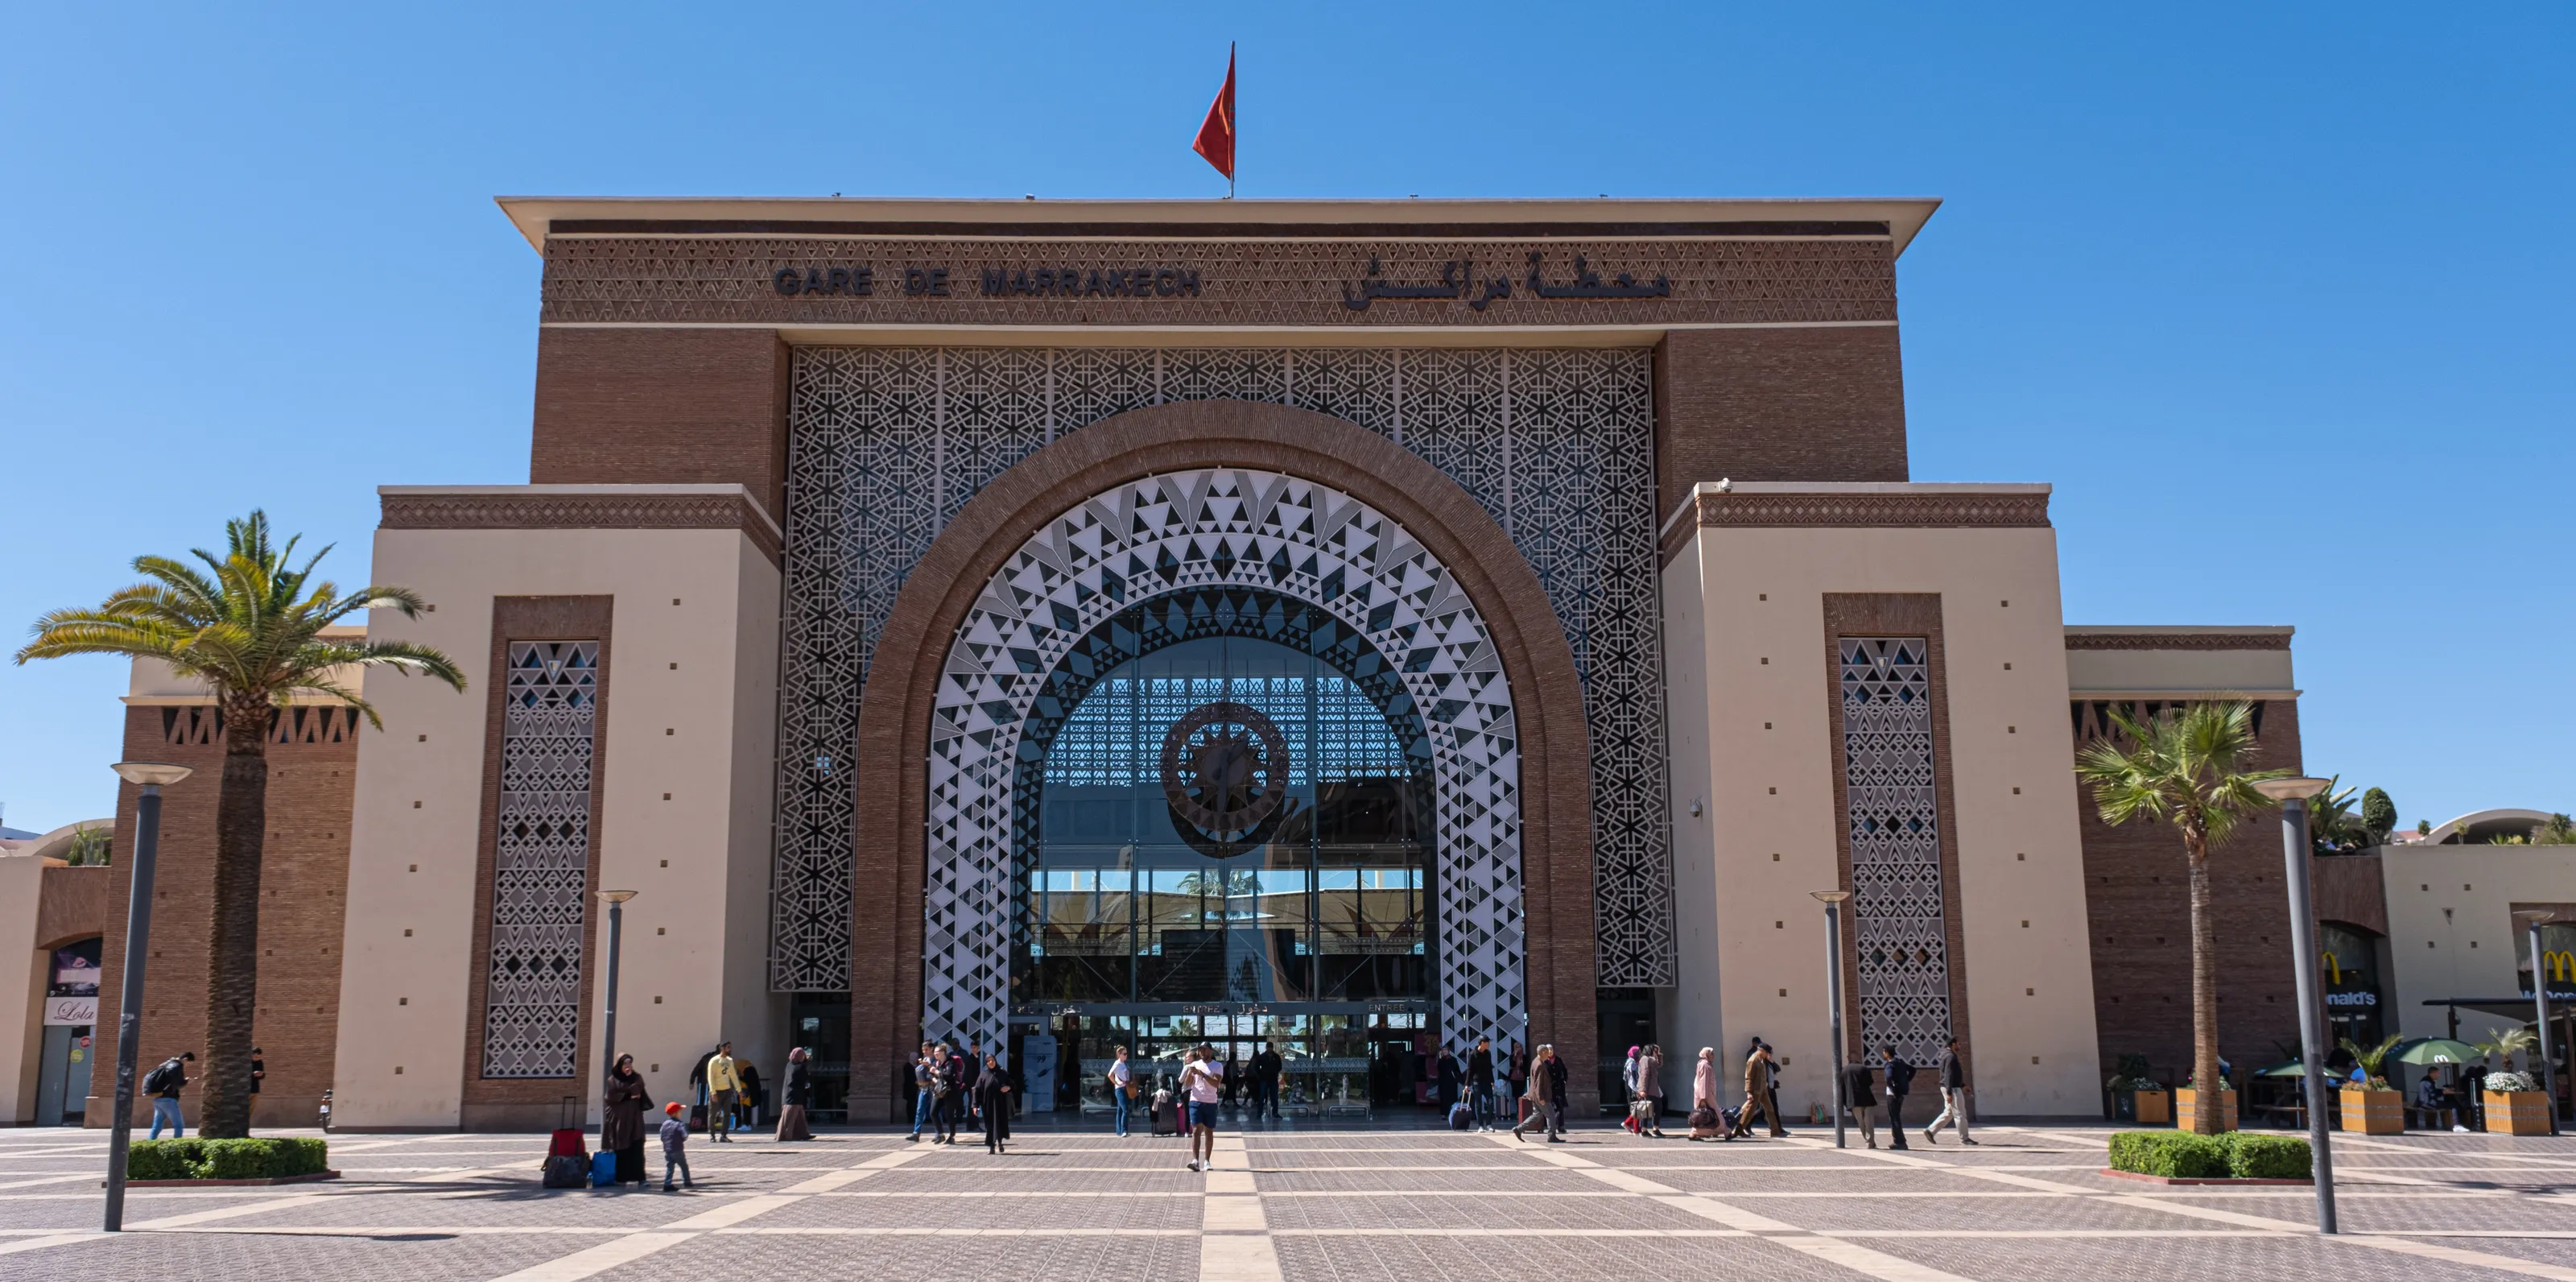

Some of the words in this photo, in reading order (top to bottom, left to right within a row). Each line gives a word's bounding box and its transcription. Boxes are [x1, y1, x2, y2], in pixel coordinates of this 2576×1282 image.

[774, 267, 873, 296] GARE
[904, 268, 949, 296] DE
[980, 269, 1200, 296] MARRAKECH
[1344, 254, 1511, 311] مراكش
[1526, 250, 1670, 298] محطة
[53, 1001, 95, 1021] Lola
[2326, 991, 2376, 1006] nald's
